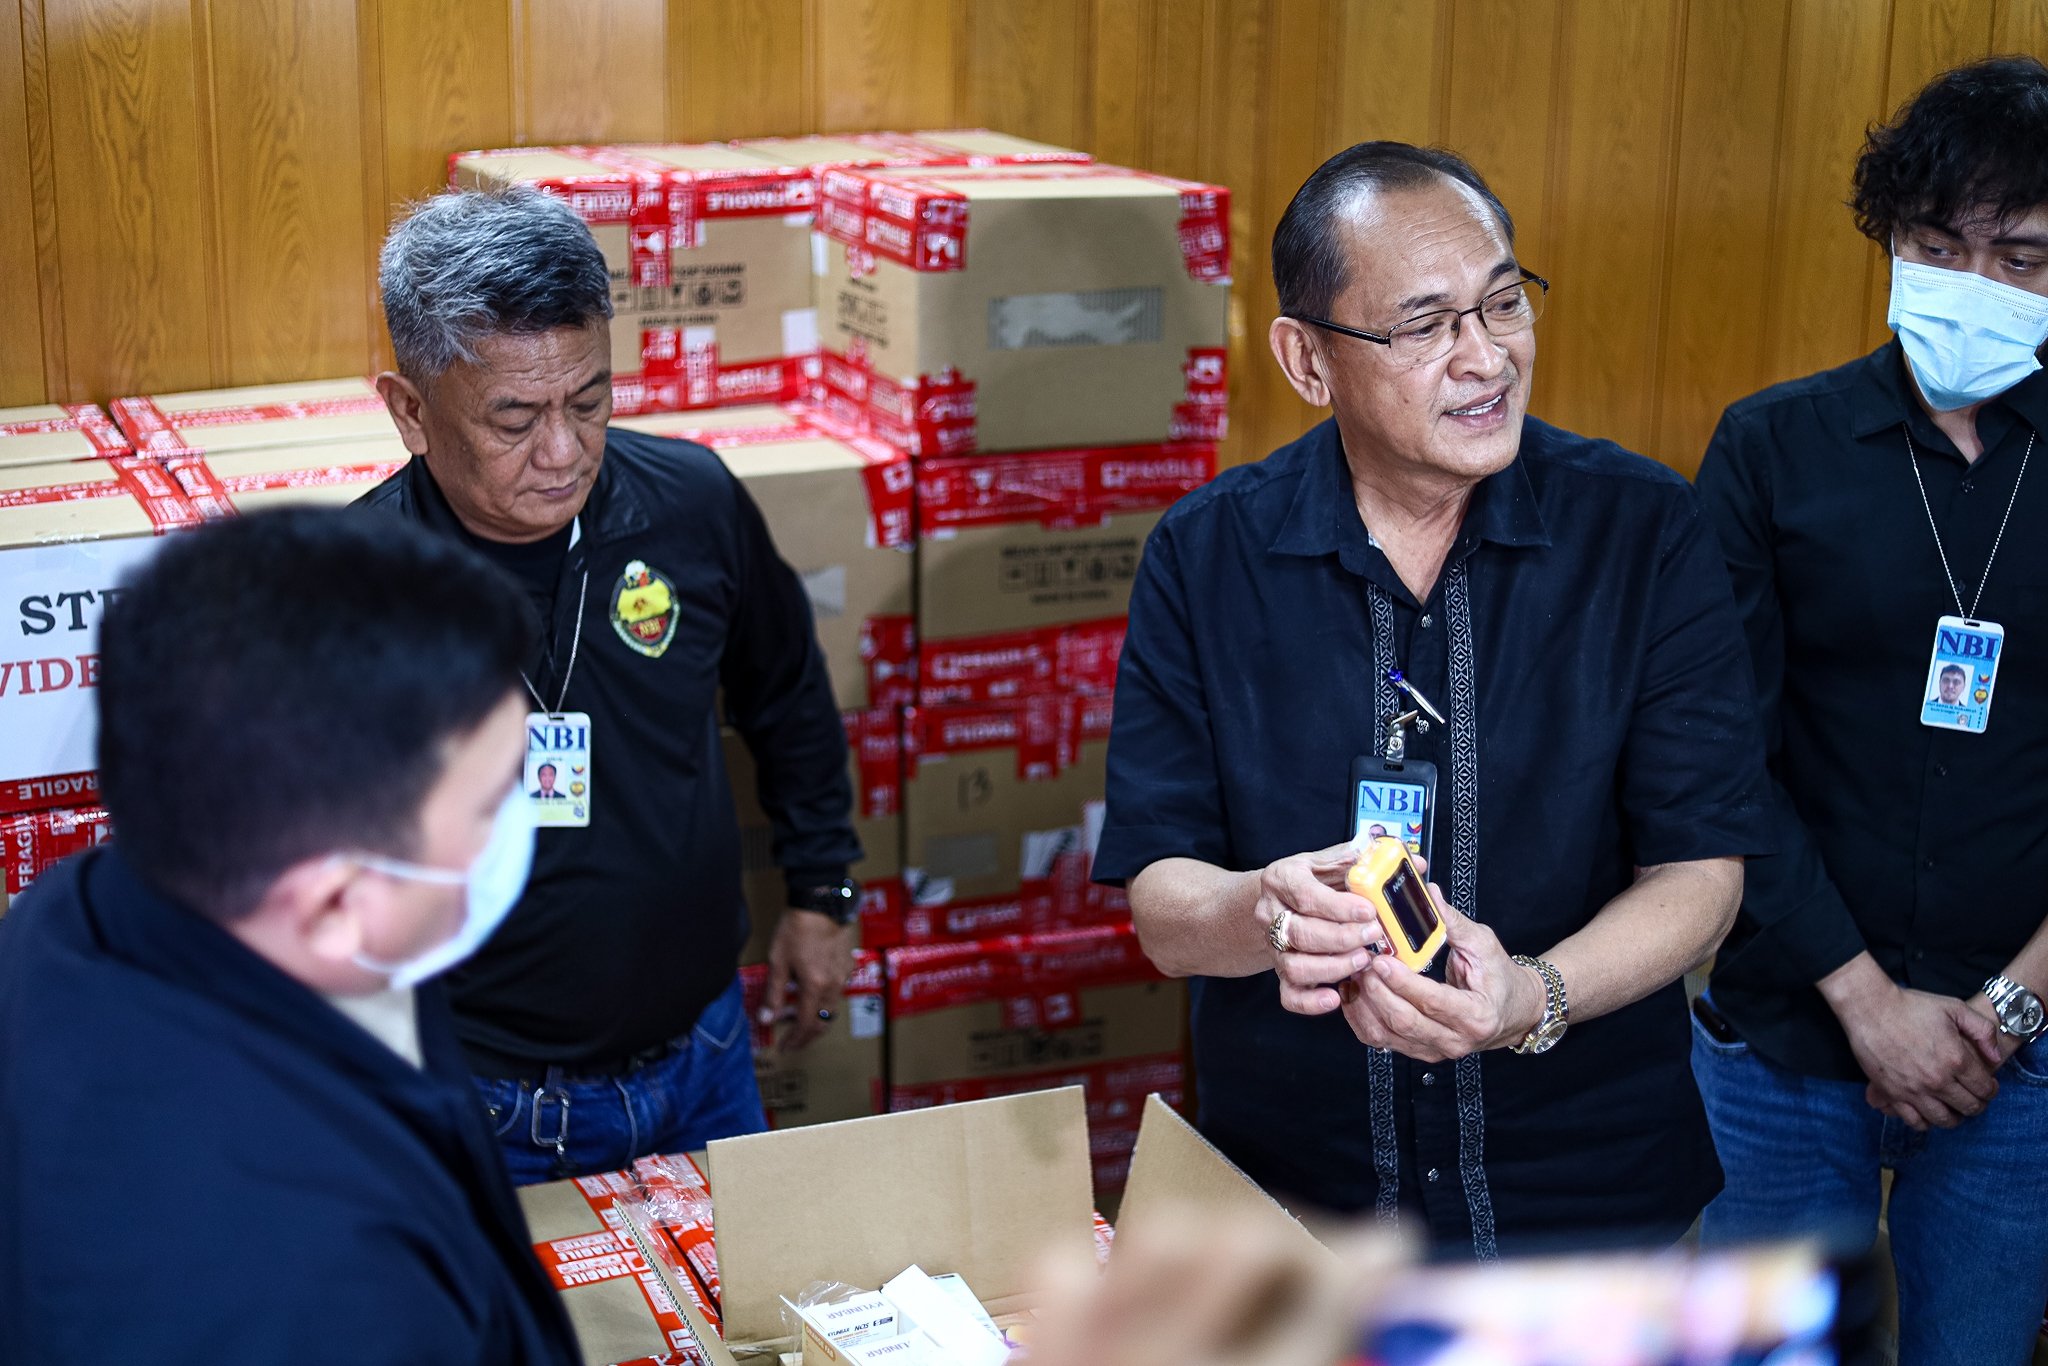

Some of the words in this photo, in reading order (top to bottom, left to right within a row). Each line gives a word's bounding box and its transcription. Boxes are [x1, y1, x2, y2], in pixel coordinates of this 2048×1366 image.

[1937, 630, 1999, 659] NBI
[528, 726, 585, 750] NBI
[1360, 785, 1422, 813] NBI
[866, 1340, 910, 1358] LINBAR
